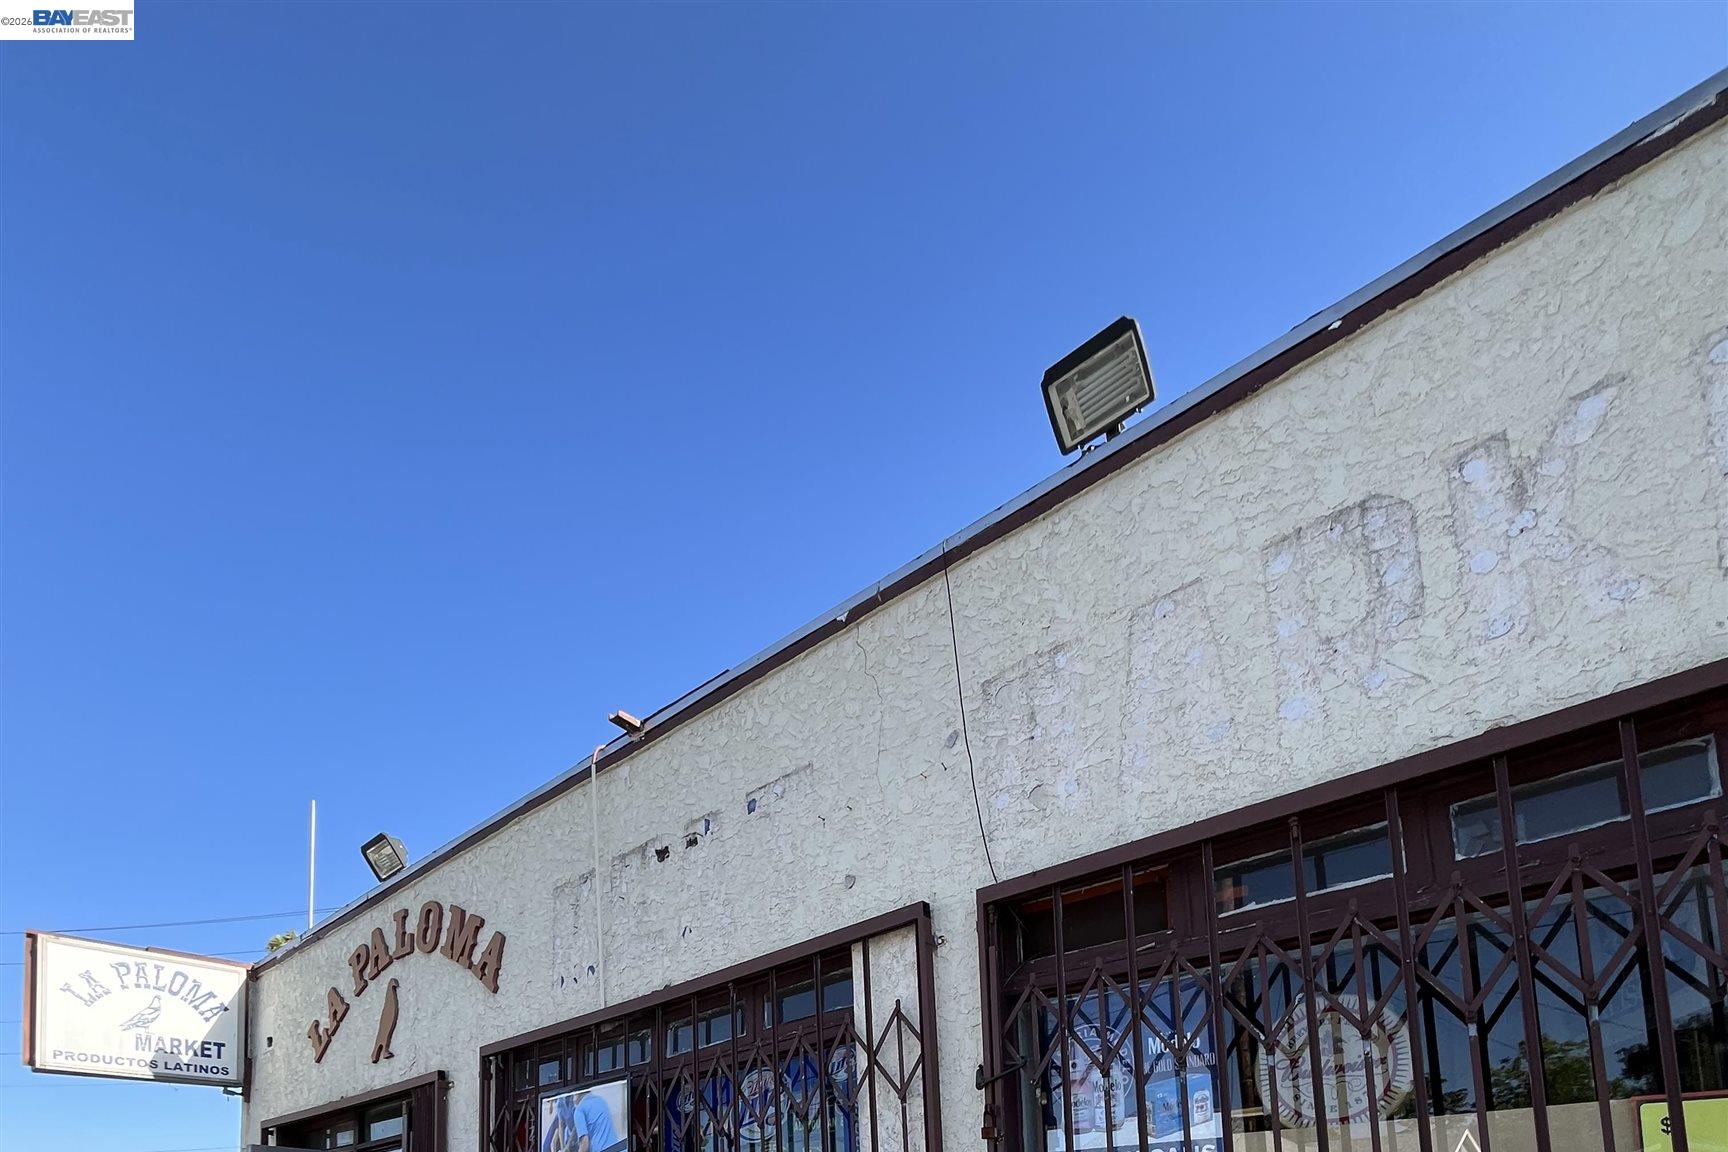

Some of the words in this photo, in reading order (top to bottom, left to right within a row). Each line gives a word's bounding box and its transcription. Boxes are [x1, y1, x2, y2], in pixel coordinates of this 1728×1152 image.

[59, 969, 112, 1007] LA
[110, 961, 230, 1023] PALOMA
[307, 986, 350, 1064] LA
[348, 900, 507, 995] PALOMA
[52, 1050, 158, 1069] PRODUCTOS
[164, 1060, 230, 1076] LATINOS
[135, 1033, 226, 1060] MARKET
